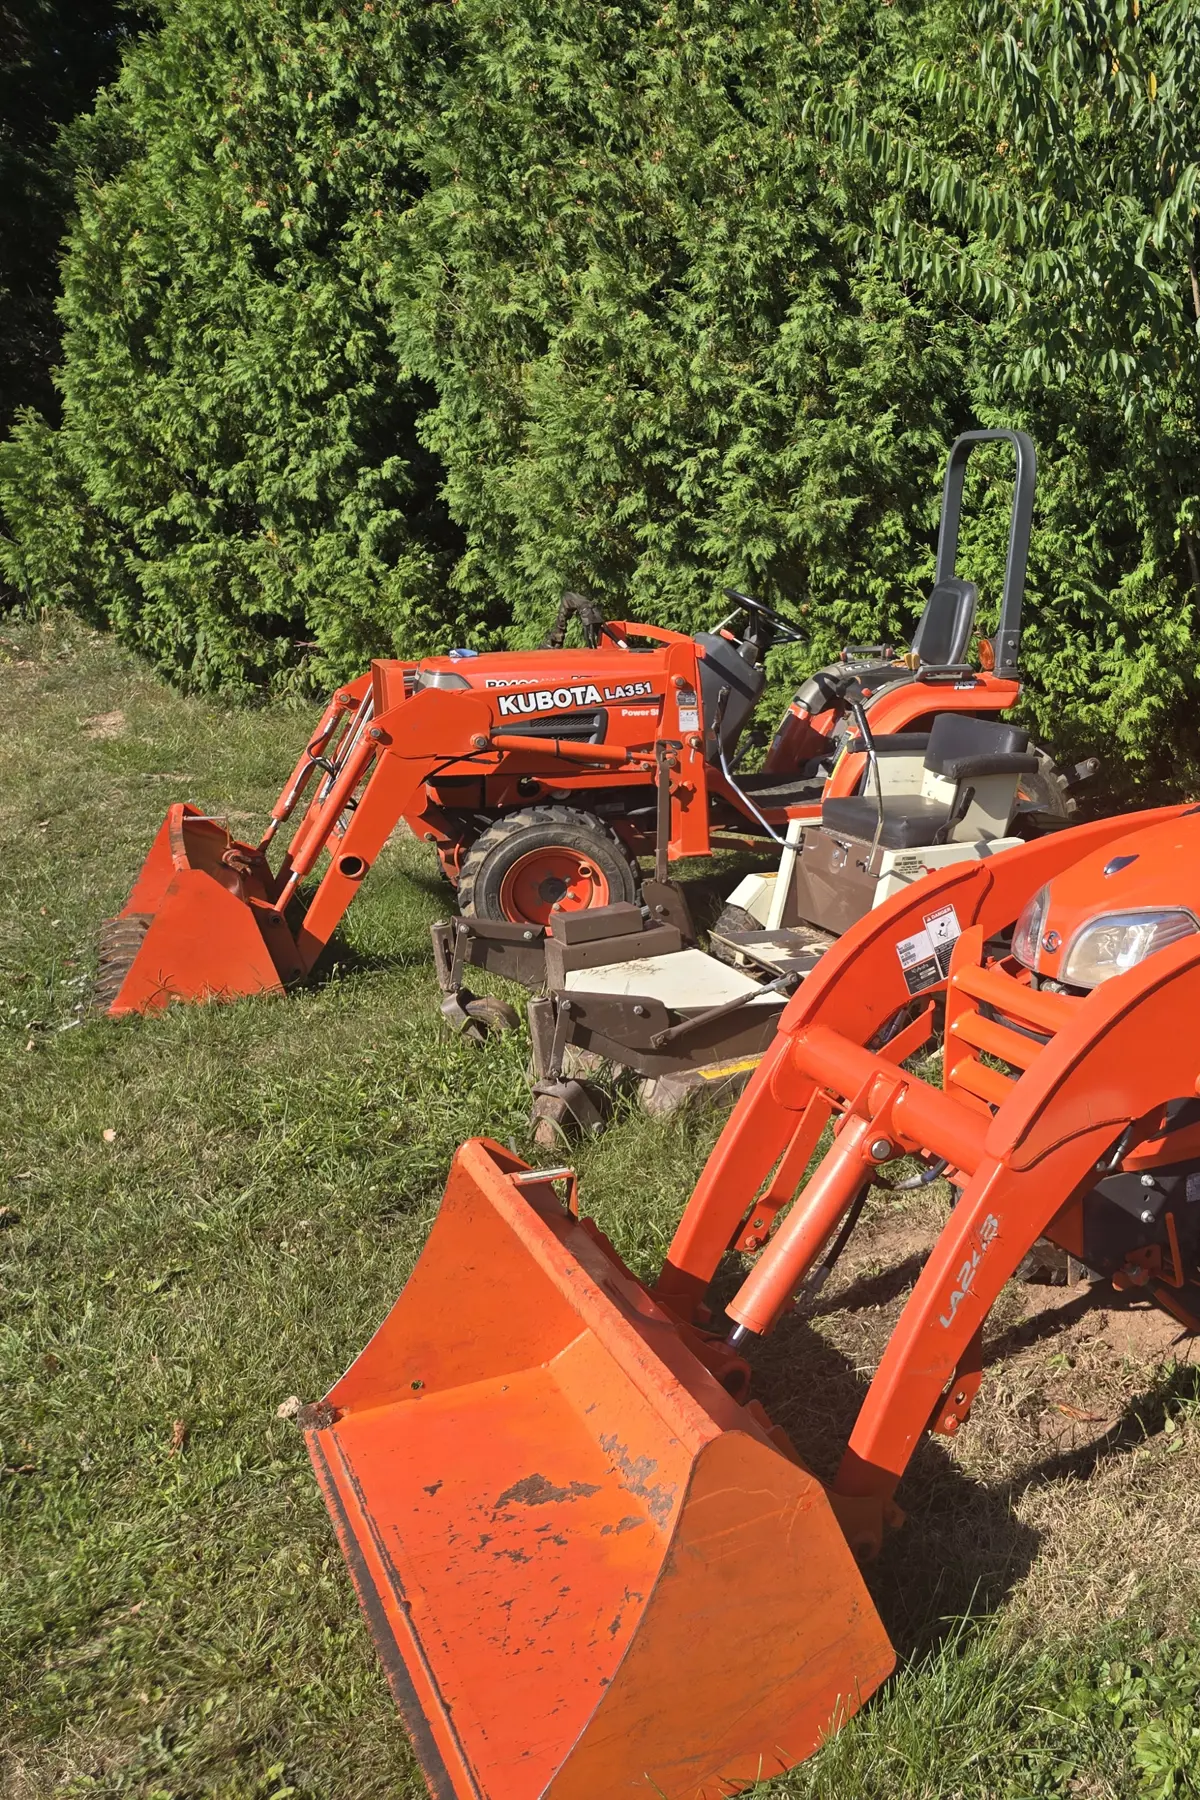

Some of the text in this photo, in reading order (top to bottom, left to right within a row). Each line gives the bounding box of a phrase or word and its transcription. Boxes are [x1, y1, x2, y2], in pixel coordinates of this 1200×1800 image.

[498, 684, 603, 716] KUBOTA
[604, 682, 653, 700] LA351
[621, 709, 649, 717] Power
